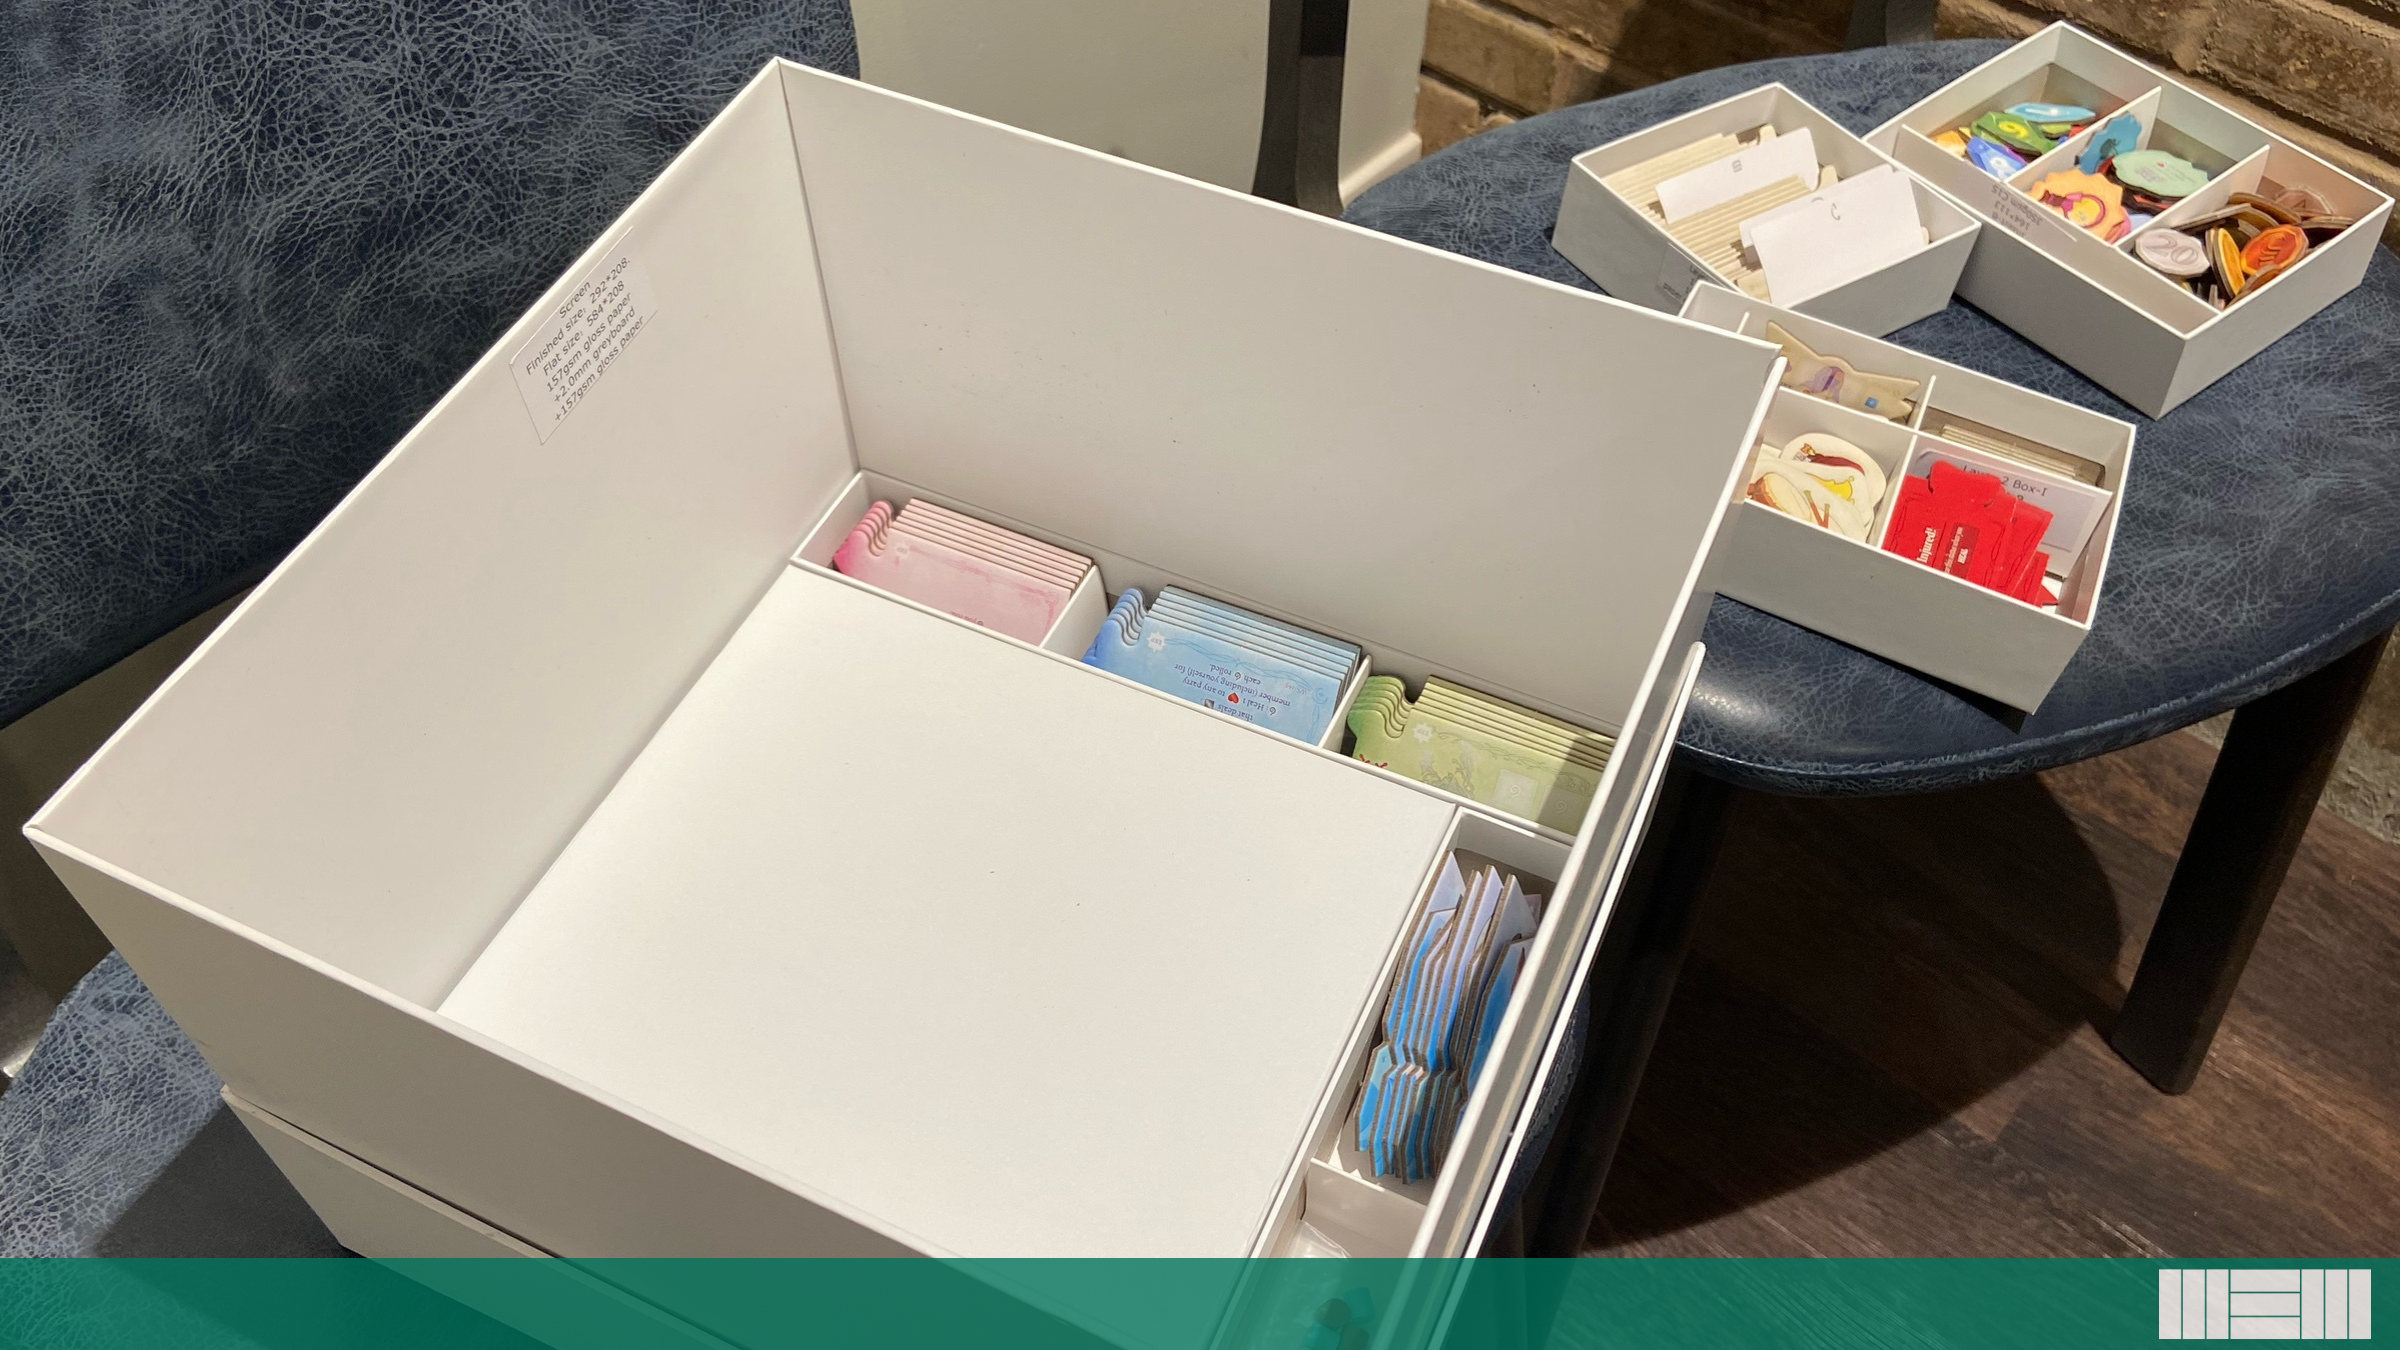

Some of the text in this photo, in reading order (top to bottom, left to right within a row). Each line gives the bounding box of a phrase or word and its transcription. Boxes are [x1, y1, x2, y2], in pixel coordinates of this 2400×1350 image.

[559, 282, 591, 318] Screen
[526, 328, 564, 376] Finished
[565, 308, 586, 333] size:
[543, 352, 562, 376] Flat
[562, 331, 584, 356] size:
[546, 292, 633, 392] 157gsm gloss paper
[554, 307, 636, 404] +2.0mm greyboard
[554, 315, 645, 422] +157gsm gloss paper
[1916, 527, 1936, 564] Injured!
[1174, 664, 1291, 707] member (including yourself) for
[1182, 676, 1201, 690] party
[1209, 664, 1232, 676] rolled.
[1244, 674, 1261, 686] each
[1202, 684, 1217, 695] any
[1218, 689, 1226, 697] to
[1247, 699, 1264, 712] Heal
[1218, 703, 1254, 722] that deals
